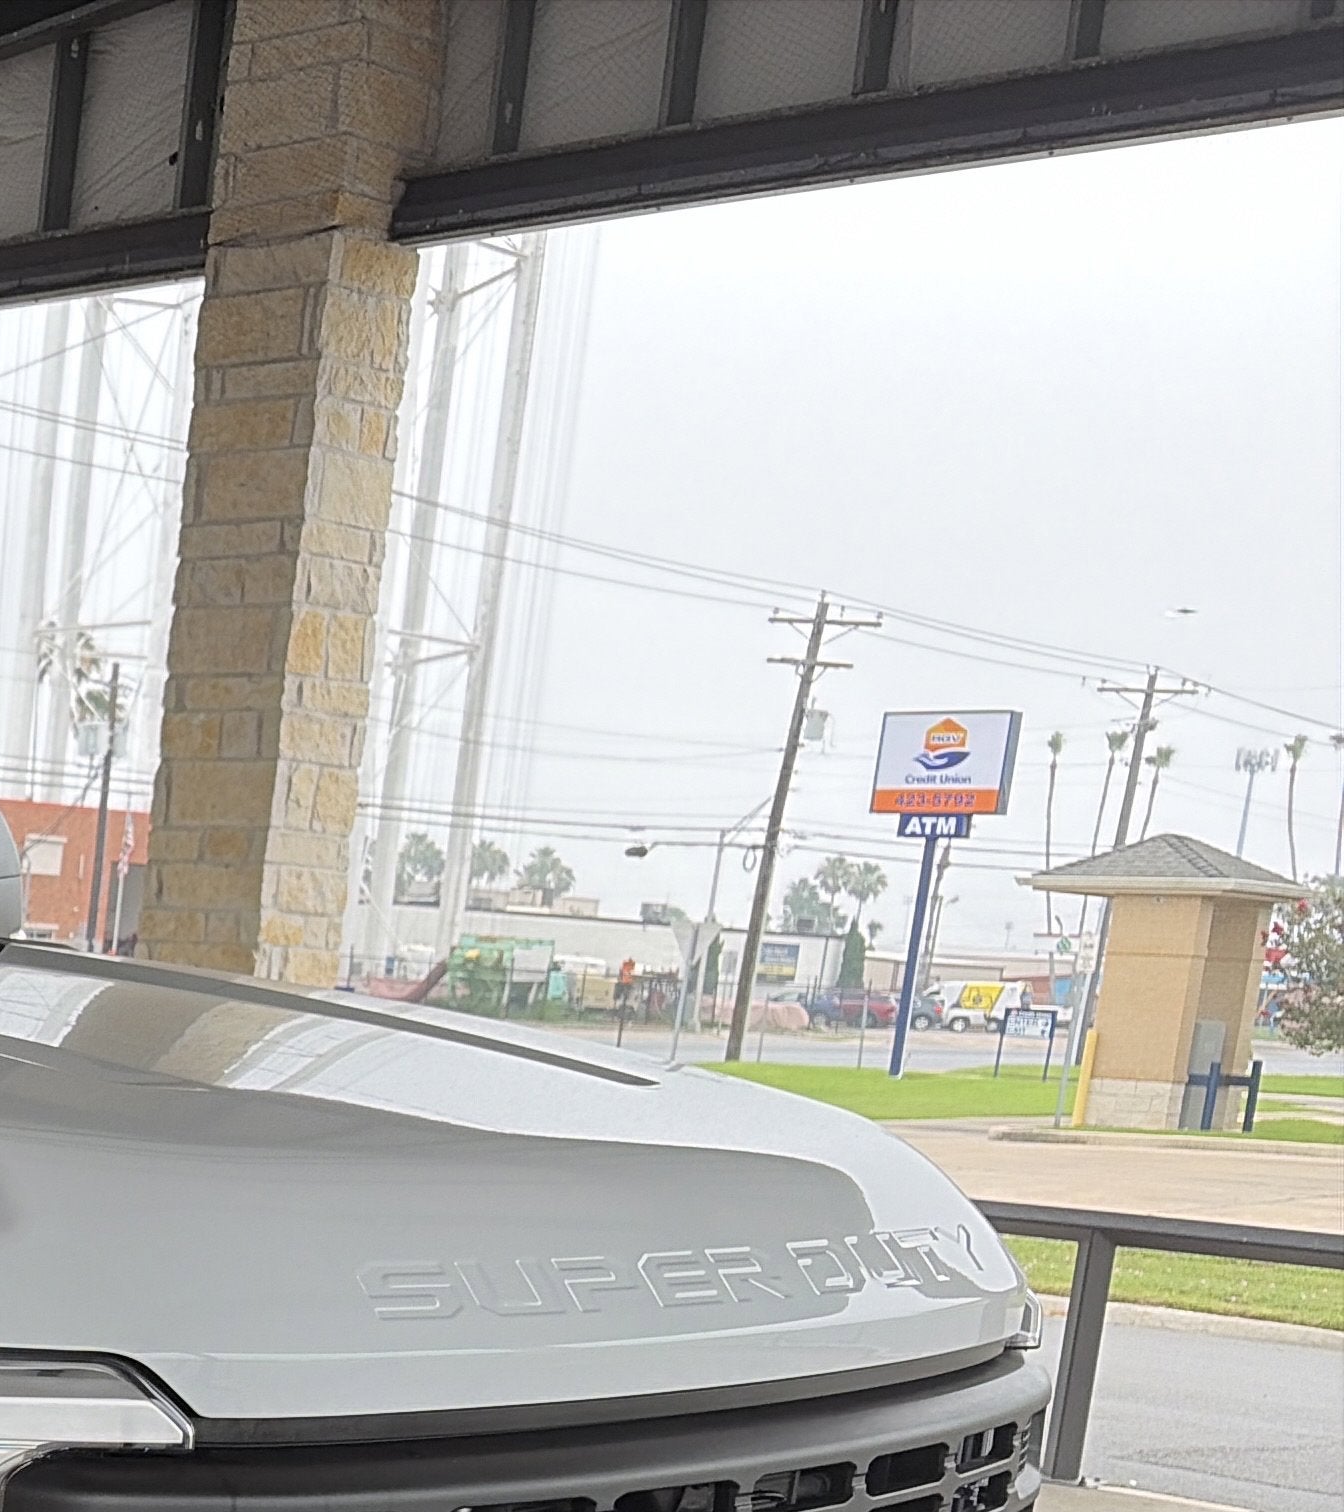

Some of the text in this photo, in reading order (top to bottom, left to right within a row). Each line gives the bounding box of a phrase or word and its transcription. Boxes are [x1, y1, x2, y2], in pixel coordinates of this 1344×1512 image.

[904, 774, 972, 785] Credit Union
[904, 816, 957, 835] ATM
[357, 1223, 985, 1321] SUPER DUTY
